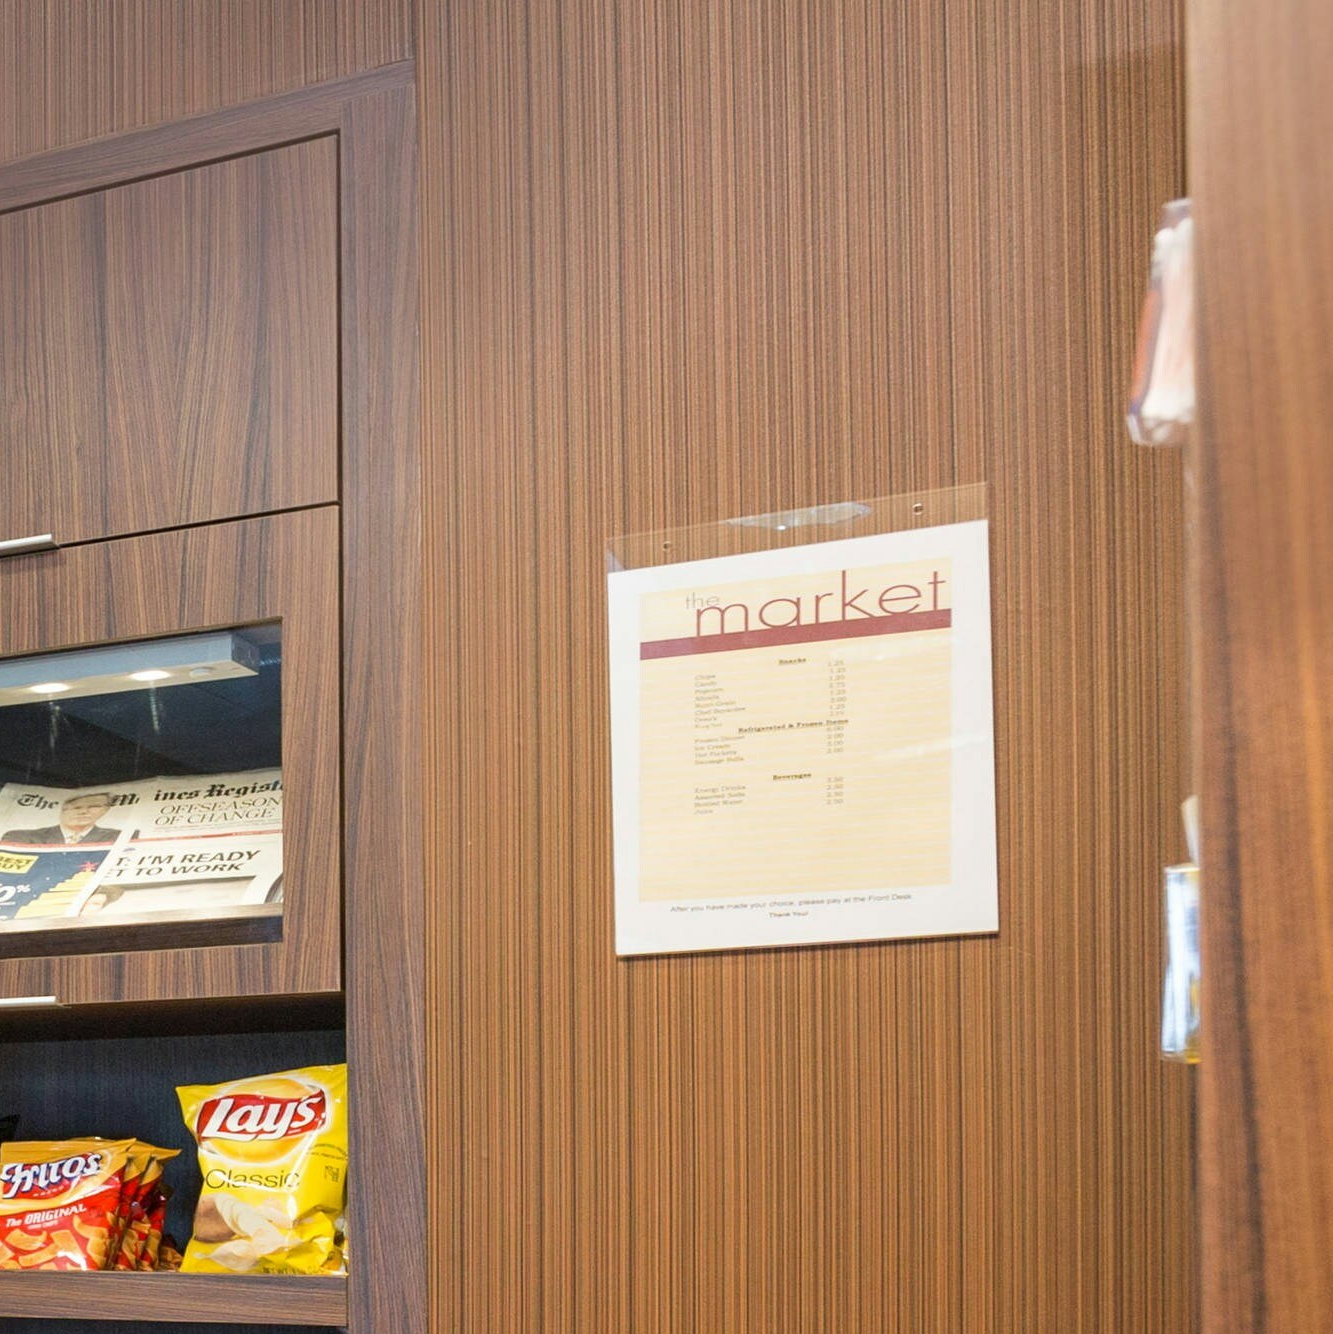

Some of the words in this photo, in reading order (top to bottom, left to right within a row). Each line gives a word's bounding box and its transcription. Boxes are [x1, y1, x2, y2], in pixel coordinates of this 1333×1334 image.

[685, 592, 720, 611] the
[696, 570, 946, 637] market
[204, 780, 283, 799] Regist
[17, 793, 59, 810] The
[160, 797, 282, 815] OFFSEASON
[154, 815, 183, 826] OF
[187, 808, 275, 824] CHANGE
[138, 854, 174, 866] I'M
[180, 850, 262, 863] READY
[135, 866, 163, 877] TO
[171, 862, 245, 875] WORK
[798, 899, 824, 907] please
[201, 1096, 322, 1141] Lay's
[0, 1153, 103, 1199] Fritos
[205, 1169, 300, 1189] Classic
[6, 1216, 22, 1227] The
[24, 1205, 87, 1226] ORIGINAL
